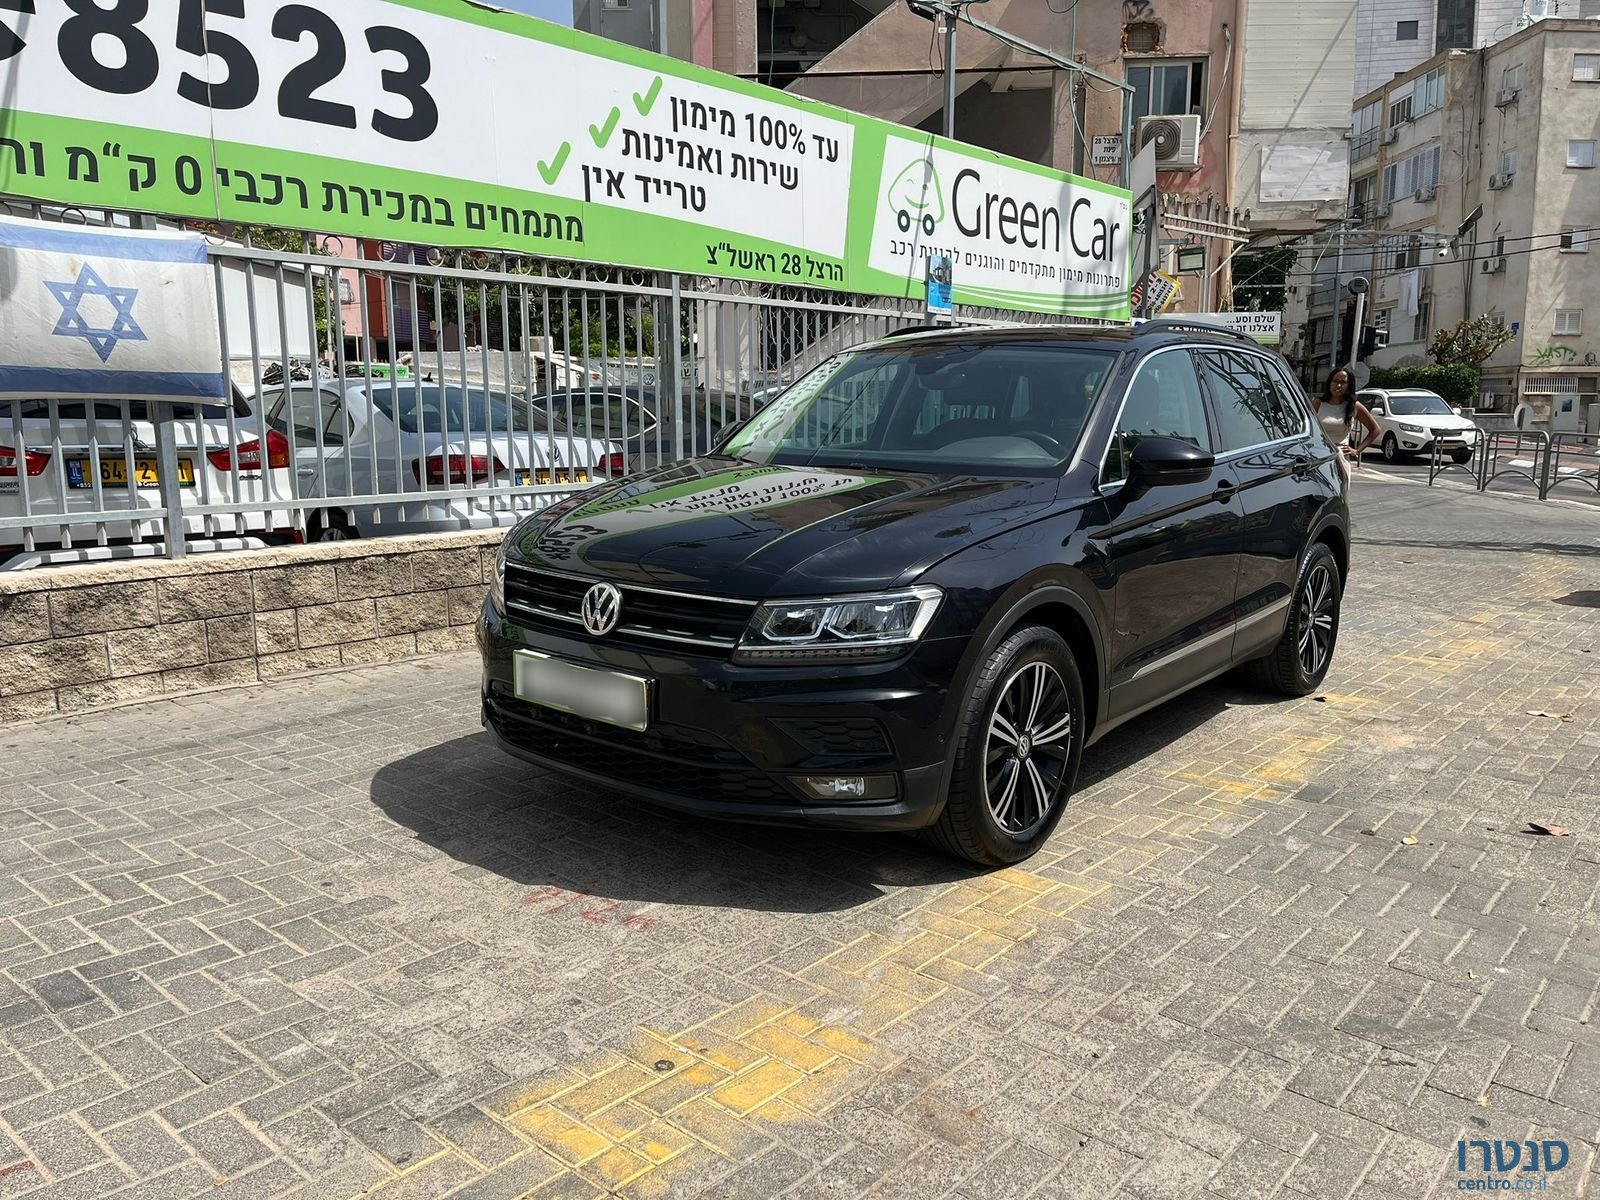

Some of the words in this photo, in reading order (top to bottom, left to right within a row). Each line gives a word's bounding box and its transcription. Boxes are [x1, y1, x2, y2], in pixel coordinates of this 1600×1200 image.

[670, 96, 736, 138] מימון
[745, 112, 806, 155] 100%
[64, 141, 157, 192] ק"מ
[621, 128, 722, 175] ואמינות
[812, 134, 839, 163] עד
[175, 155, 202, 196] 0
[216, 168, 309, 209] רכבי
[581, 164, 625, 203] אין
[730, 153, 799, 190] שירות
[321, 181, 455, 227] במכירת
[635, 174, 706, 213] טרייד
[465, 201, 584, 243] מתמחים
[952, 168, 1060, 252] Green
[1069, 197, 1120, 262] Car
[705, 242, 776, 273] ראשל"צ
[781, 252, 801, 276] 28
[890, 239, 914, 257] רכב
[965, 252, 1004, 271] והוגנים
[806, 255, 843, 282] הרצל
[1009, 259, 1056, 279] מתקדמים
[1059, 267, 1083, 283] מימון
[1086, 272, 1120, 288] פתרונות
[1248, 324, 1275, 332] אצלנו
[1254, 314, 1275, 323] שלם
